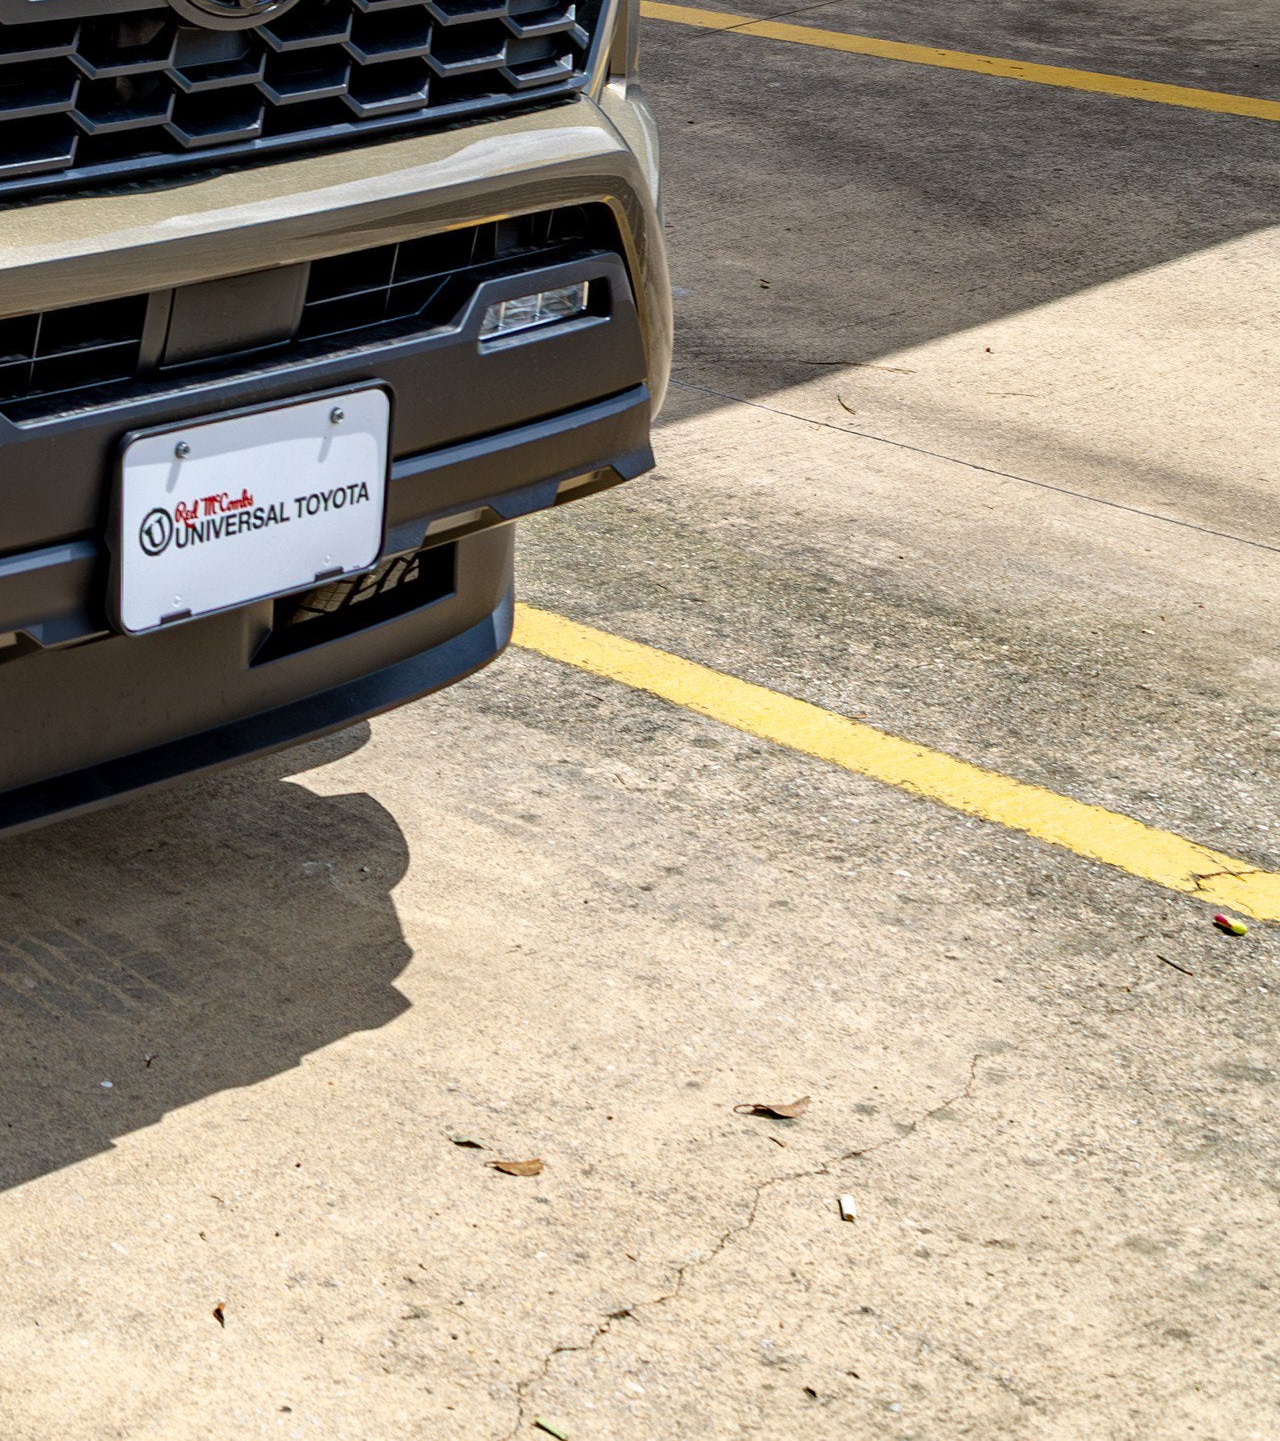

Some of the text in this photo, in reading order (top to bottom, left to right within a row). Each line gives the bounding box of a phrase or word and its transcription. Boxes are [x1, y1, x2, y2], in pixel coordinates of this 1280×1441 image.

[174, 500, 199, 524] Red
[175, 481, 370, 549] UNIVERSAL TOYOTA
